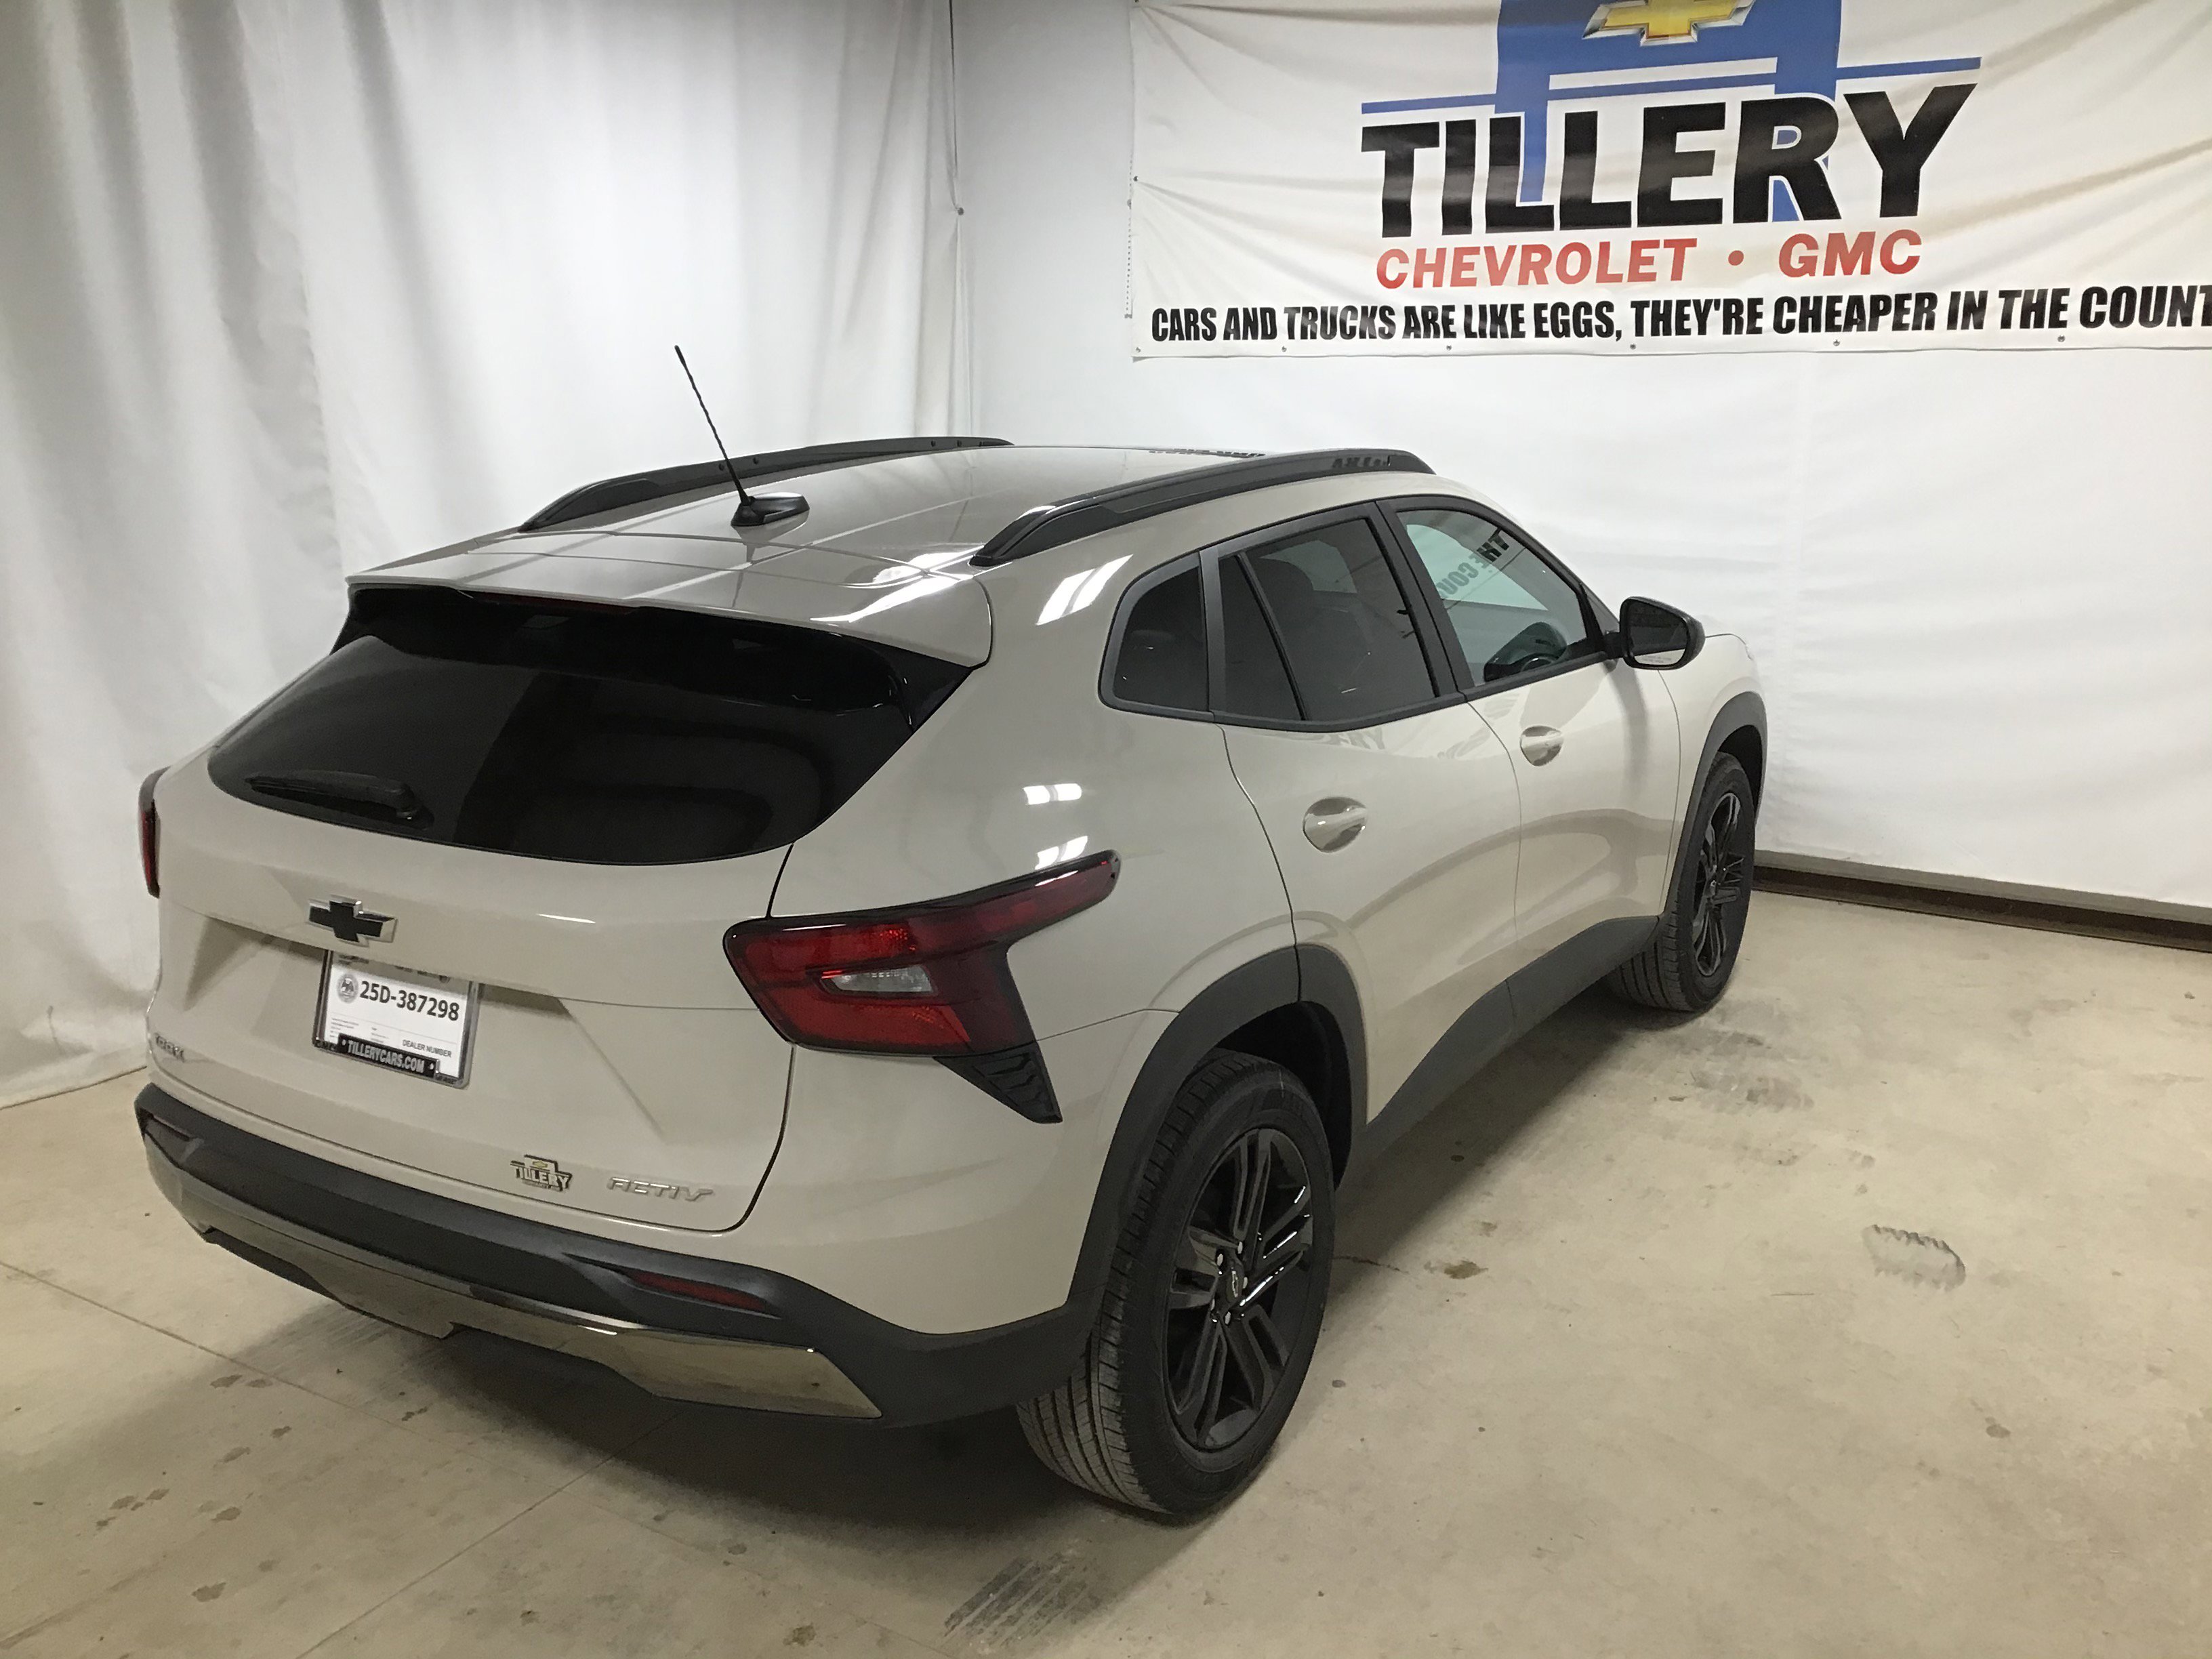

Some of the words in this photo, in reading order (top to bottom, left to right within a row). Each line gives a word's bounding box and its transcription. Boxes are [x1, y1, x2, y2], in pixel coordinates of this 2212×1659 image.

[1361, 83, 1977, 238] TILLERY
[1376, 238, 1697, 289] CHEVROLET
[1778, 230, 1921, 278] GMC
[1152, 307, 1216, 341] CARS
[1223, 306, 1277, 340] AND
[1284, 305, 1396, 340] TRUCKS
[1402, 304, 1456, 339] ARE
[1463, 303, 1525, 339] LIKE
[1534, 301, 1622, 342] EGGS,
[1630, 298, 1763, 337] THEY'RE
[1773, 292, 1938, 333] CHEAPER
[1947, 291, 1988, 330] IN
[1999, 288, 2070, 329] THE
[2079, 285, 2212, 329] COUNT
[360, 981, 459, 1021] 25D-387298
[348, 1040, 425, 1073] TILLERYCARS.COM
[402, 1039, 426, 1051] DEALER
[426, 1045, 452, 1058] NUMBER
[512, 1165, 570, 1189] TILLERY
[607, 1176, 714, 1202] ACTIV
